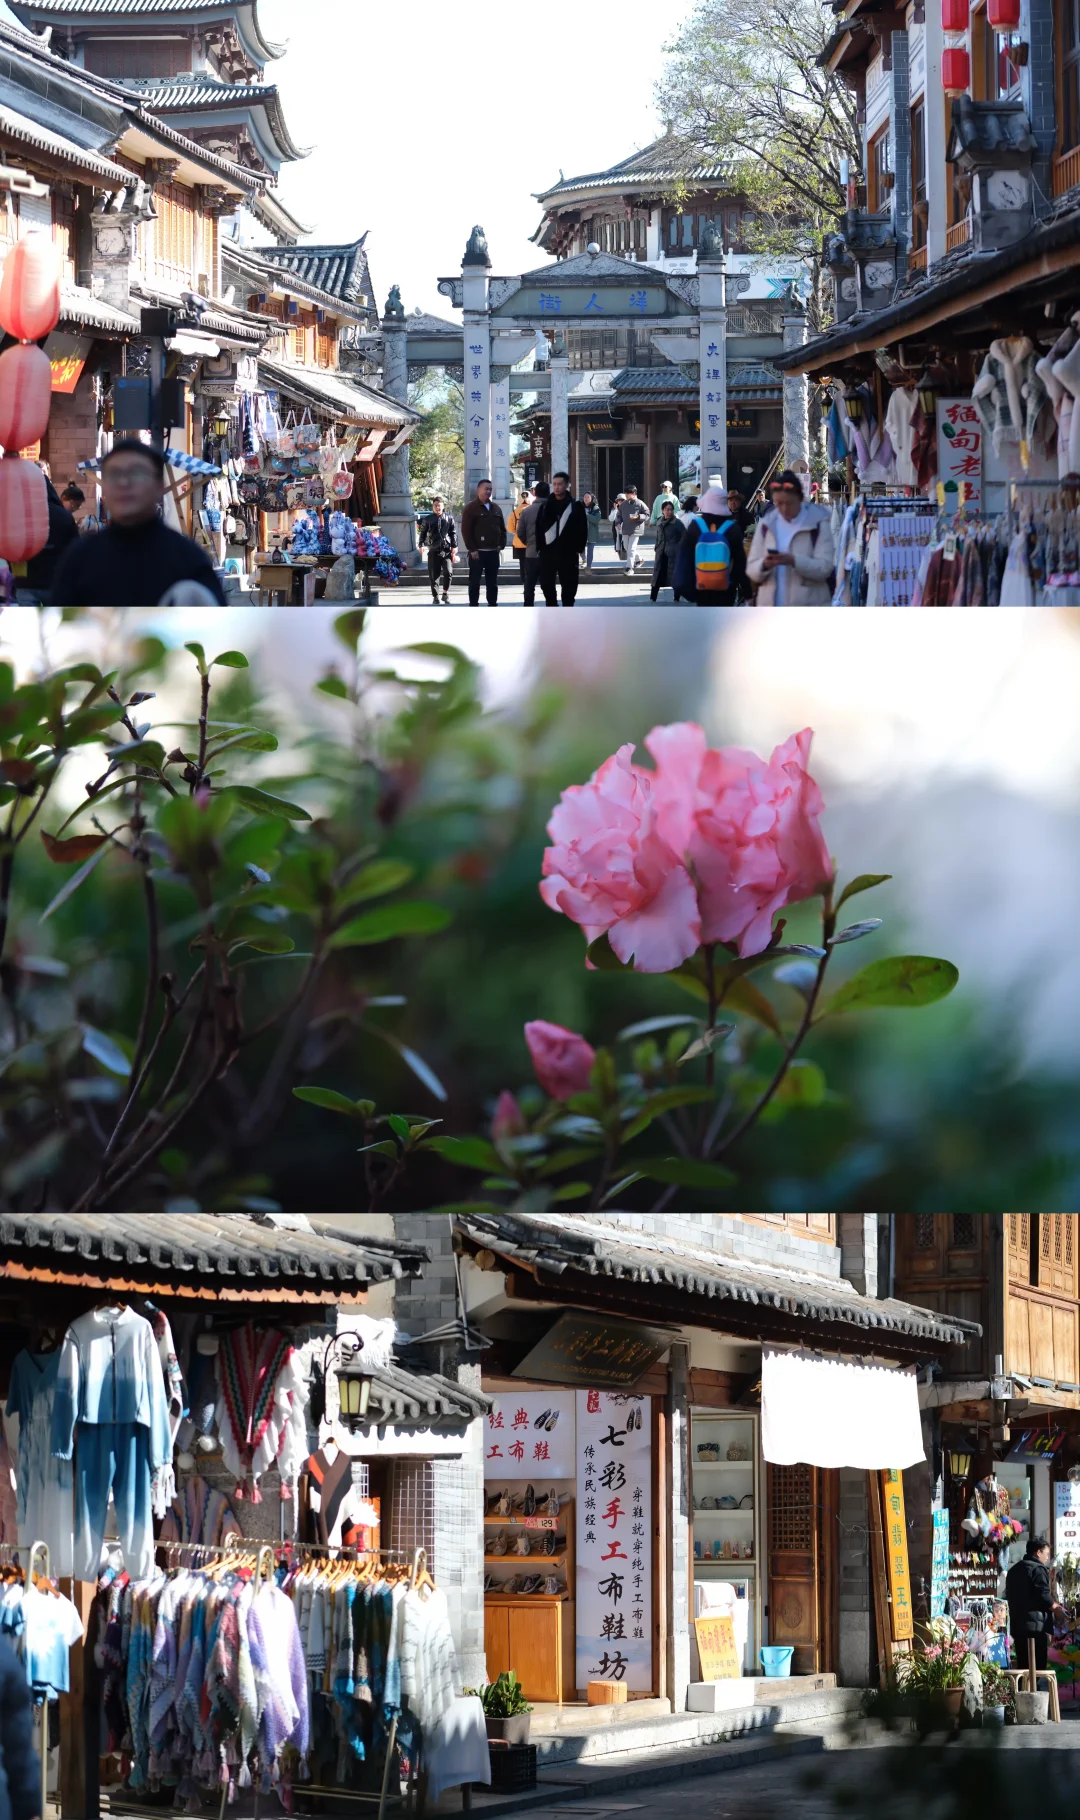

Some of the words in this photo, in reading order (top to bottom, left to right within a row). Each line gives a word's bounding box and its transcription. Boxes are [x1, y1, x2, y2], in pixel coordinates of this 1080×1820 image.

[469, 344, 484, 456] 世界共分享
[533, 435, 543, 458] 古茗
[945, 403, 981, 524] 缅甸老玉
[487, 1440, 551, 1463] 工布鞋
[489, 1407, 530, 1431] 经典
[541, 1519, 553, 1528] 129
[584, 1444, 597, 1544] 传承民族经典
[598, 1425, 629, 1681] 七彩手工布鞋坊
[632, 1486, 645, 1640] 穿鞋就穿纯手工布鞋
